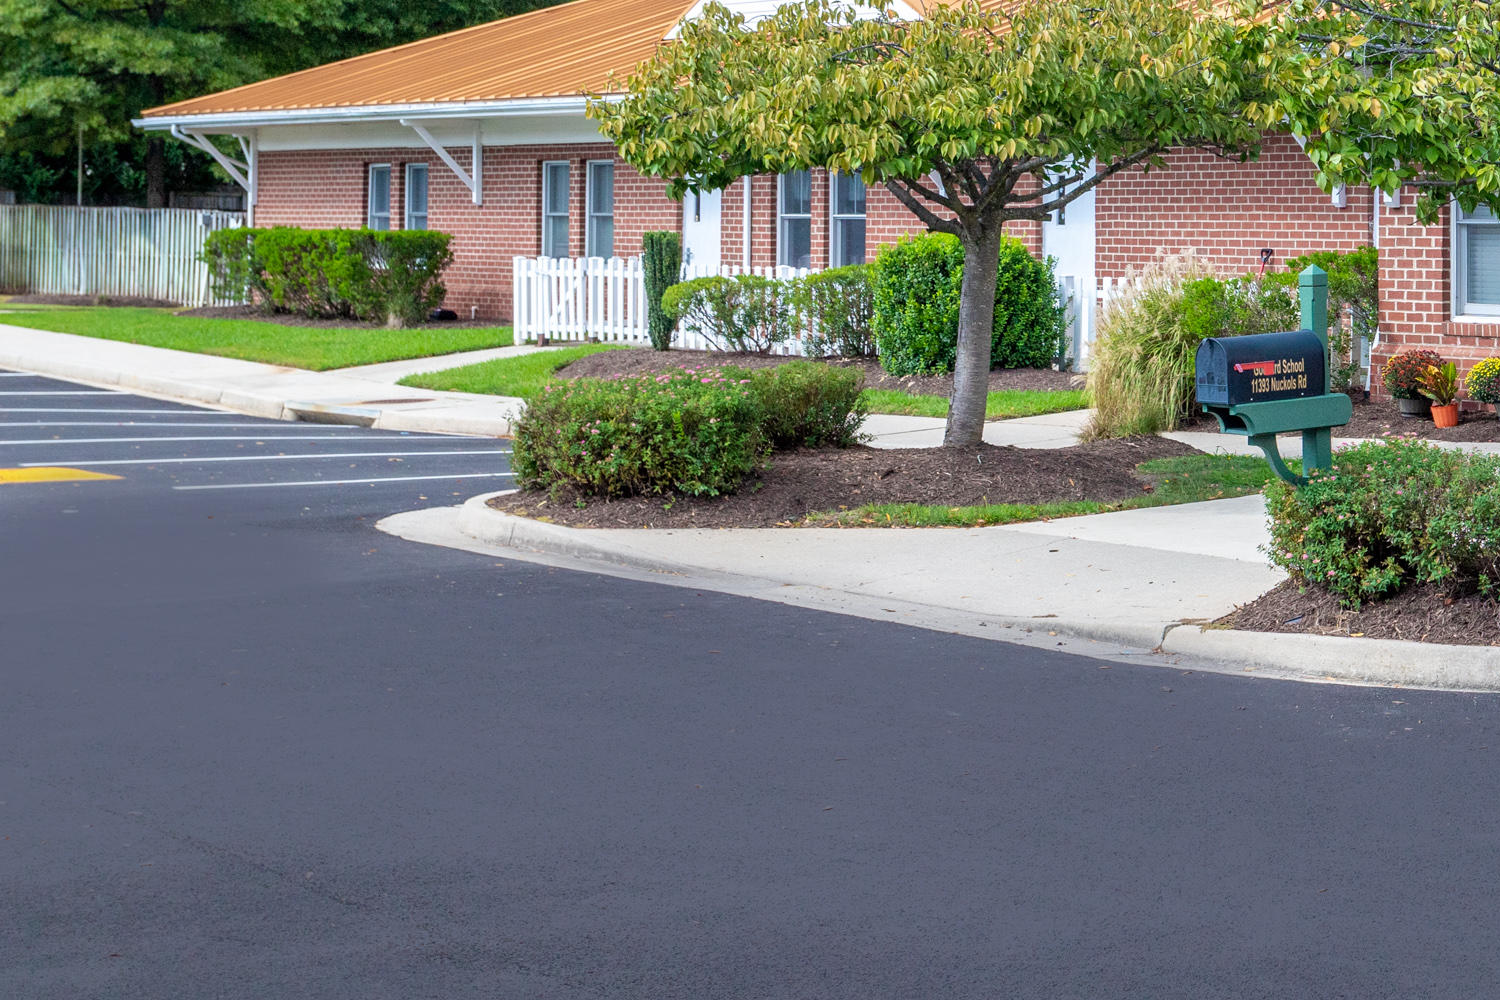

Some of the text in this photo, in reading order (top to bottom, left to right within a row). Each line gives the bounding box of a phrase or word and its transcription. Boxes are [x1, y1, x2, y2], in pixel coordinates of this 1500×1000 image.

[1282, 357, 1305, 374] School
[1271, 375, 1297, 392] Nuckols
[1297, 373, 1307, 390] Rd
